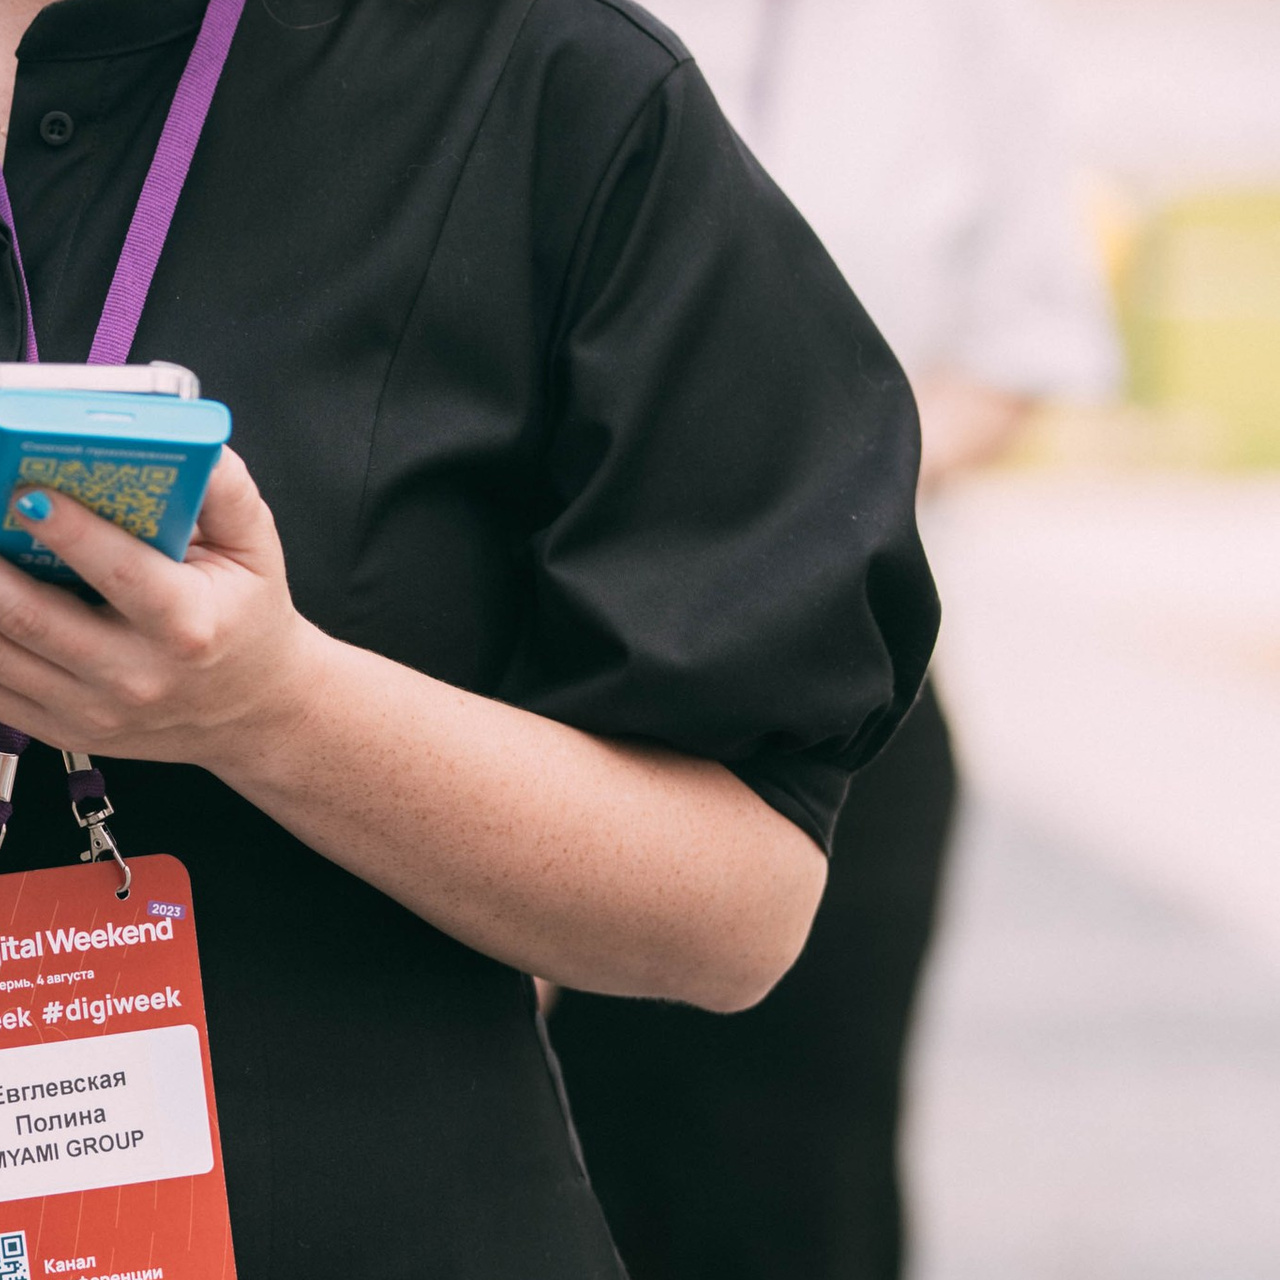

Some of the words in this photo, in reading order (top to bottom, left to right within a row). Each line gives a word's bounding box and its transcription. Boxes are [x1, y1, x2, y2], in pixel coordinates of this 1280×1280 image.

[151, 903, 181, 917] 2023
[45, 917, 173, 955] Weekend
[36, 974, 45, 987] 4
[46, 969, 95, 989] августа
[42, 986, 182, 1025] #digiweek
[16, 1107, 106, 1135] Полина
[66, 1129, 144, 1157] GROUP
[44, 1256, 96, 1274] Канал
